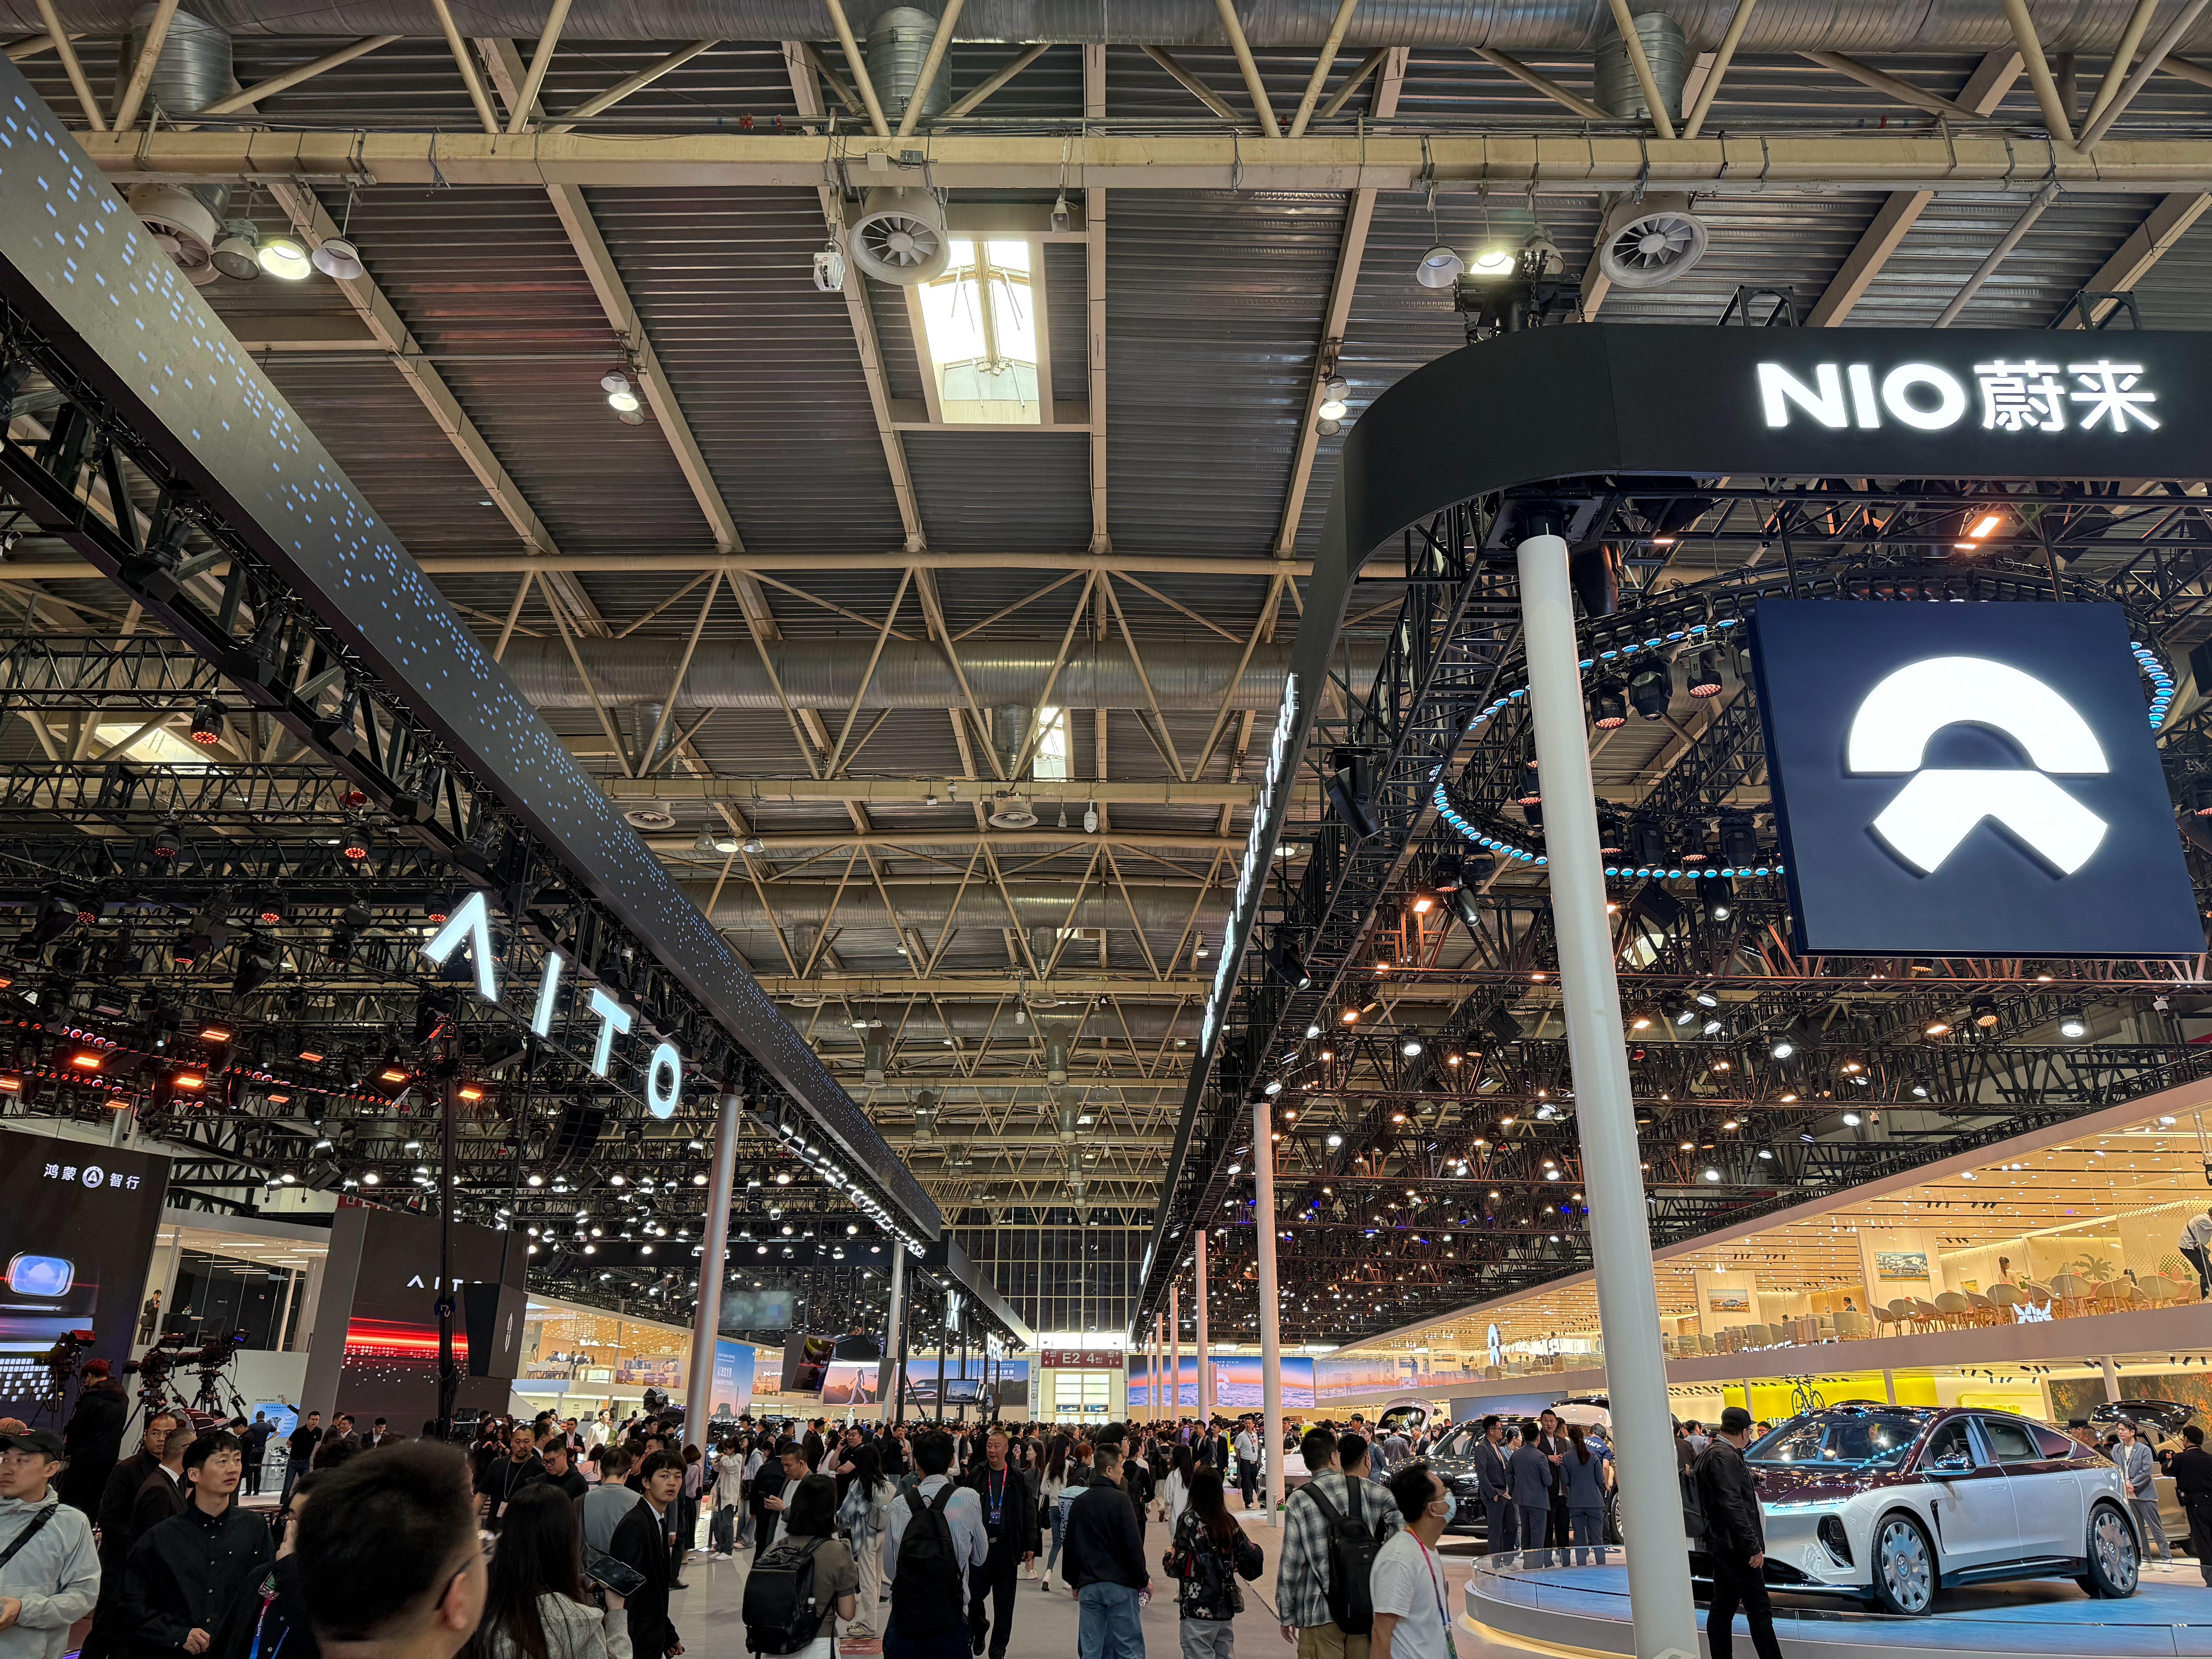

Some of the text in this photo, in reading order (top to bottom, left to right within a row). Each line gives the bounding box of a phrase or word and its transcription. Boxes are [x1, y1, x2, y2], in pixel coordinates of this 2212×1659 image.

[1757, 359, 2160, 433] NIO 蔚来
[419, 892, 682, 1120] AITO
[43, 1163, 140, 1190] 鸿蒙 智行
[407, 1275, 483, 1292] AIT
[1062, 1353, 1095, 1364] E2 4
